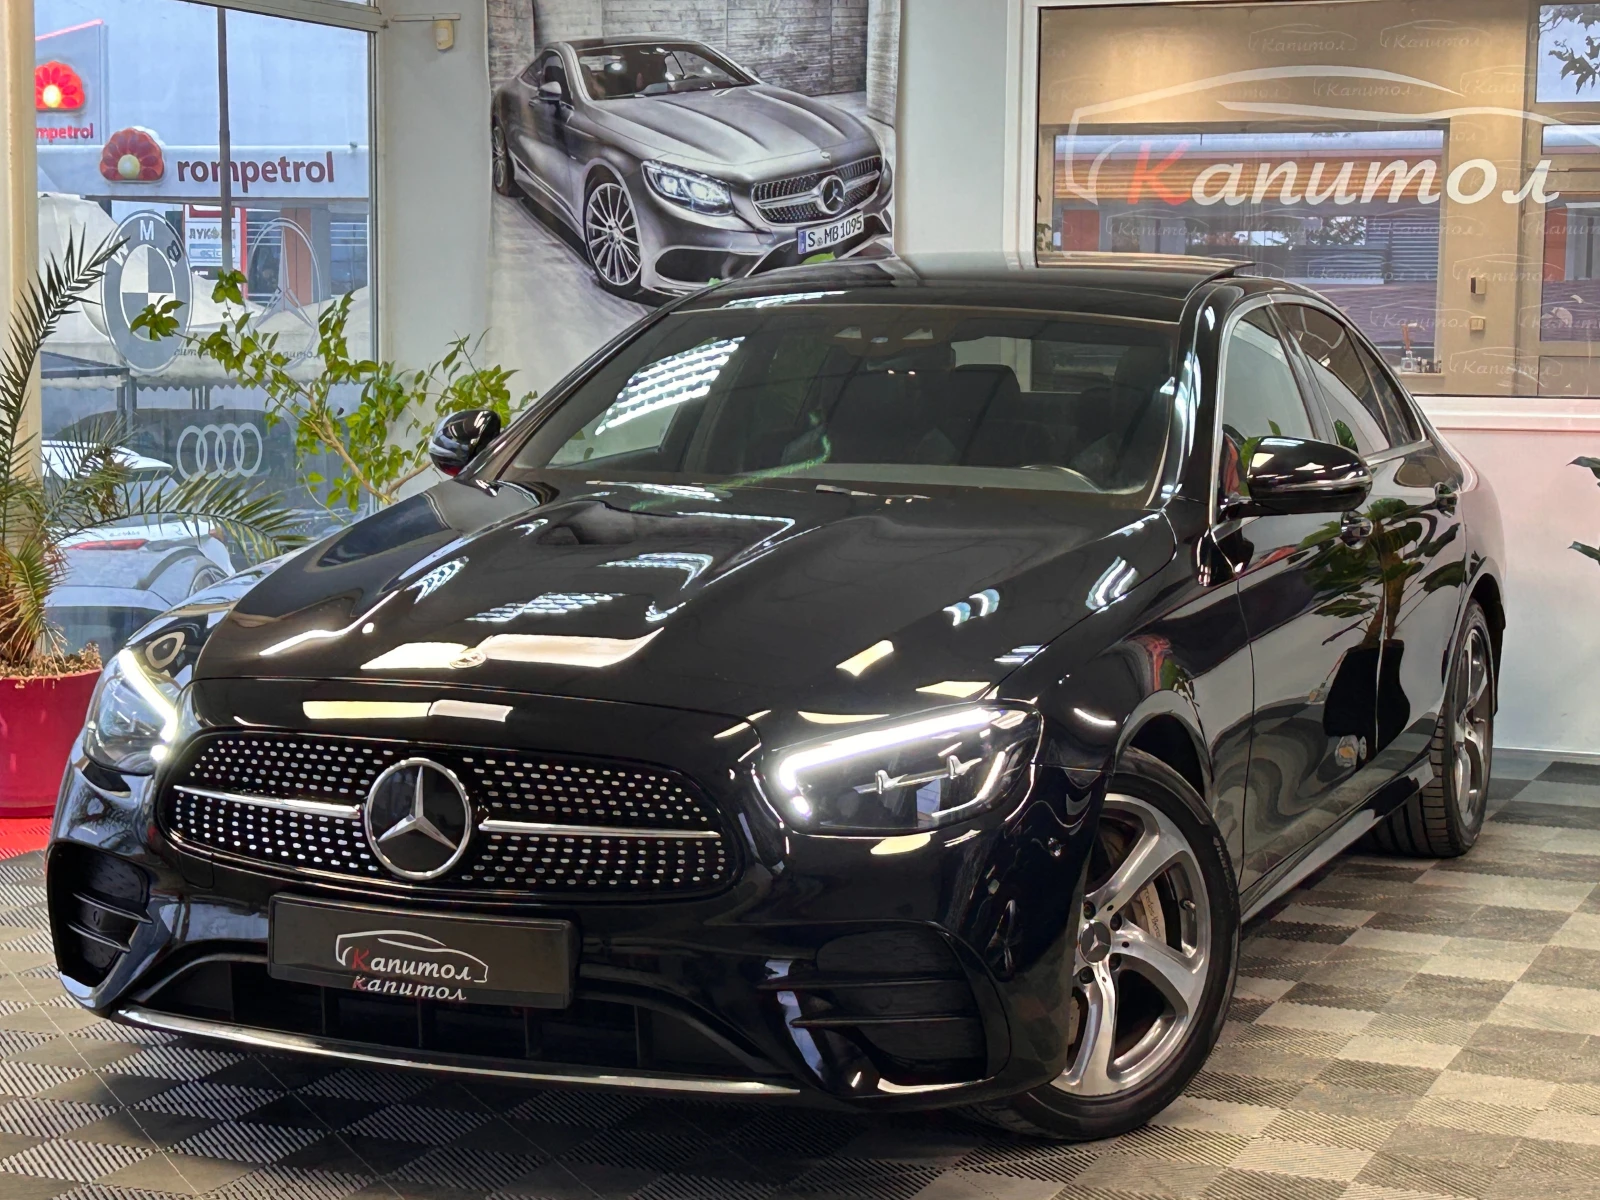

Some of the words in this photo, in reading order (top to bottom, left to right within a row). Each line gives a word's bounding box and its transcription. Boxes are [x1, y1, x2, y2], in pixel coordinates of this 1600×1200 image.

[36, 122, 94, 145] mpetrol
[177, 151, 334, 193] rompetrol
[1127, 142, 1559, 206] Капитол
[808, 231, 816, 248] S
[352, 947, 472, 981] Капитол
